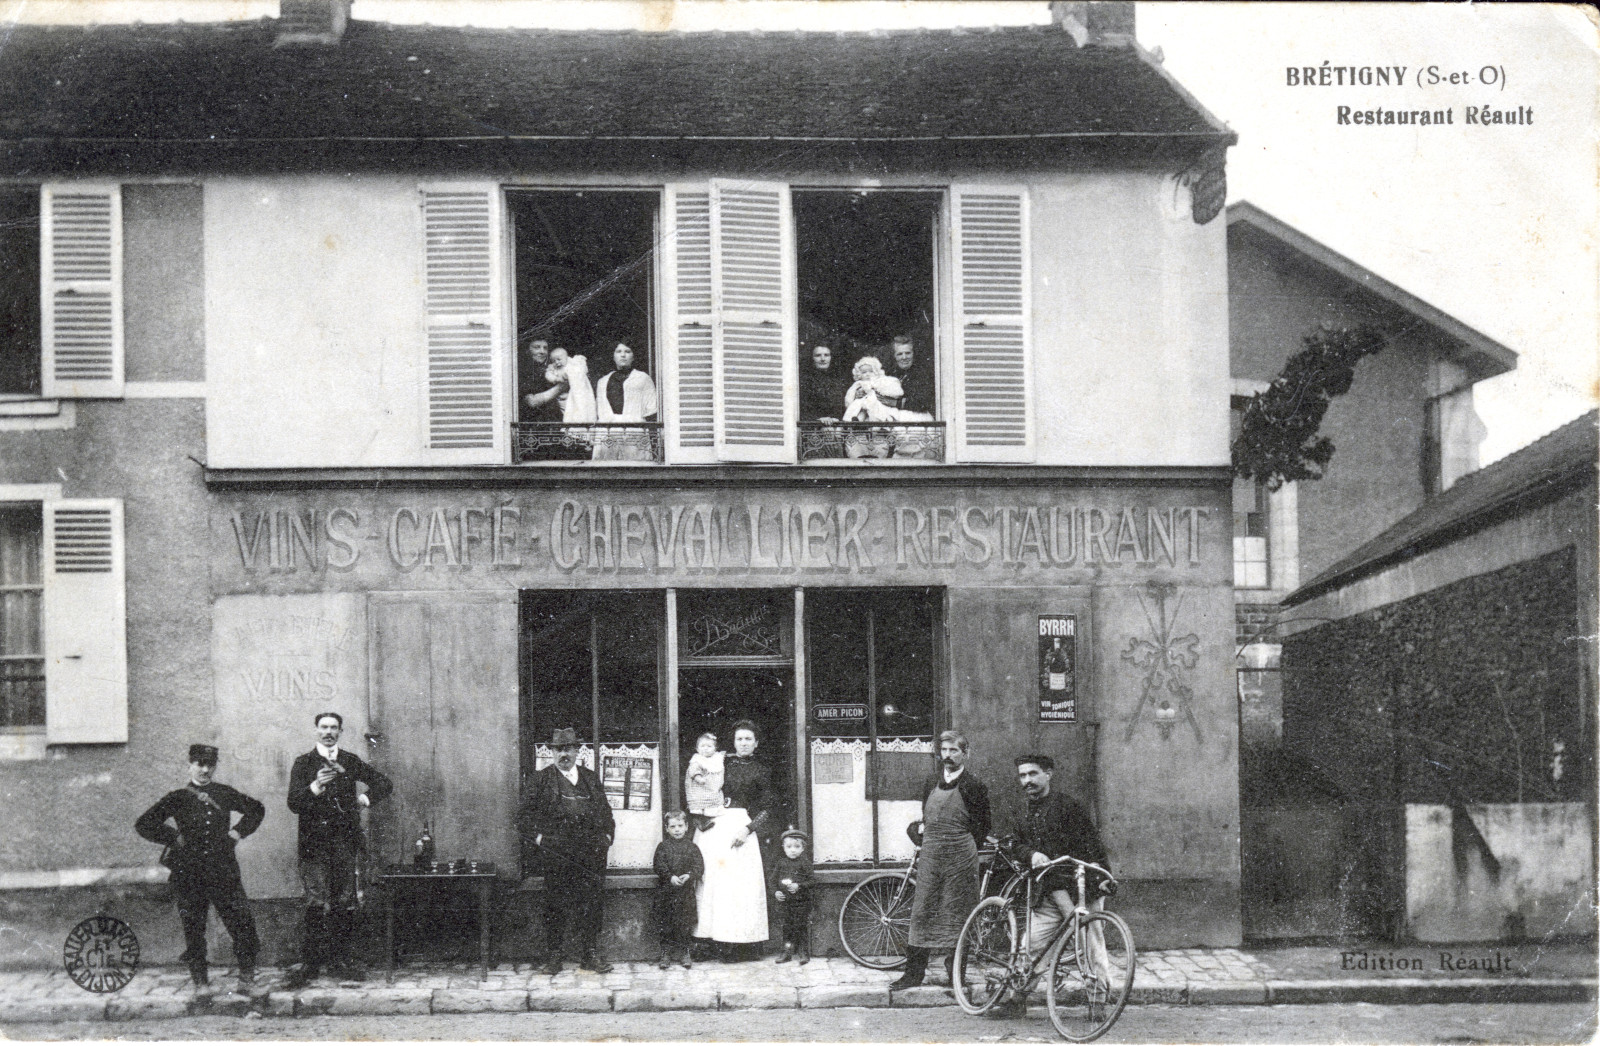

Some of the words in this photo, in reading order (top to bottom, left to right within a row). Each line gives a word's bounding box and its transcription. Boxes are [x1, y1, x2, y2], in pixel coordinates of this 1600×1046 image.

[895, 505, 1210, 570] RESTAURANT
[1039, 619, 1075, 636] BYRRH
[239, 666, 338, 702] VINS
[840, 708, 864, 717] PICON
[1052, 700, 1075, 711] TONIQUE
